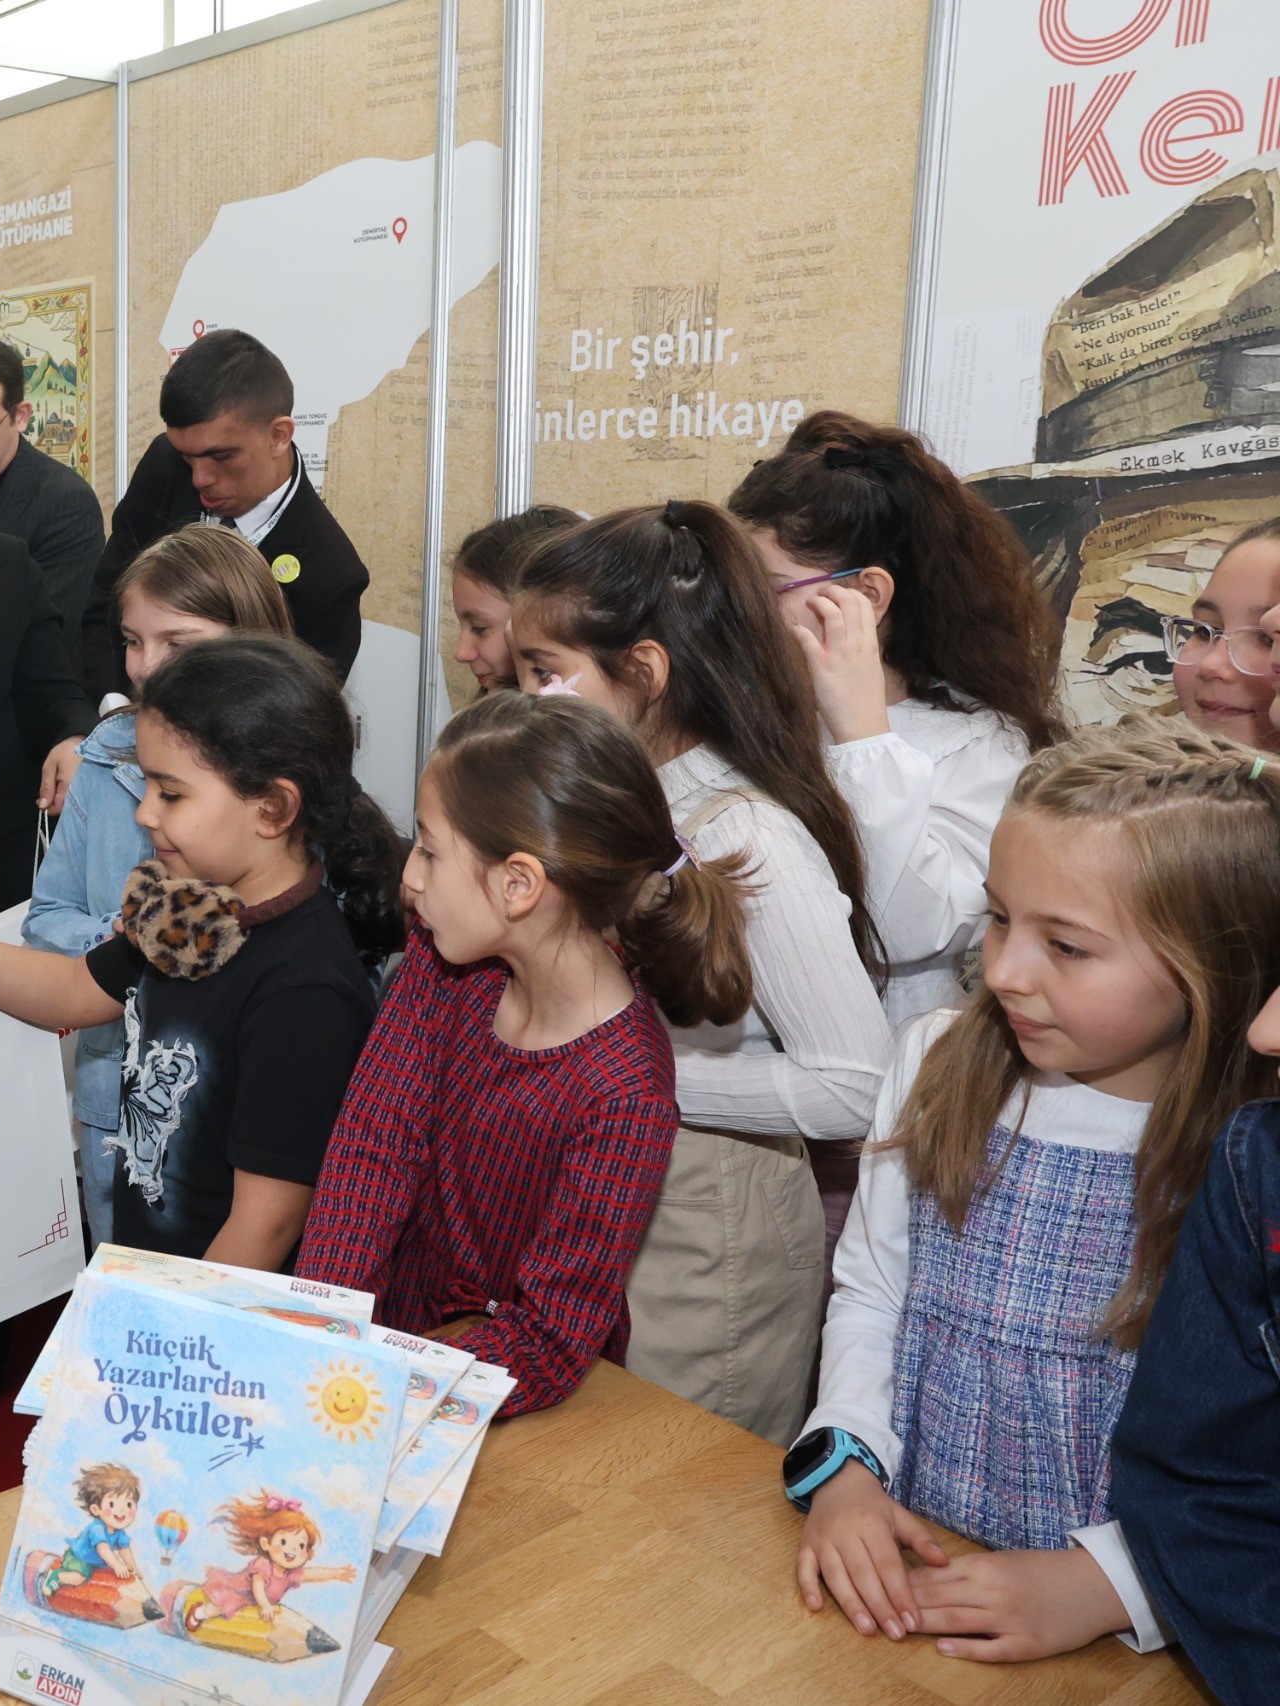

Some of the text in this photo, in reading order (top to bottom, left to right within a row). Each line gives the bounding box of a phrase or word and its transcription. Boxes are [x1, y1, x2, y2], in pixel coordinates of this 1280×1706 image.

[1038, 69, 1280, 207] Ke
[1110, 307, 1135, 329] bak
[570, 327, 622, 372] Bir
[631, 317, 739, 380] şehir,
[1120, 345, 1136, 361] da
[1140, 336, 1174, 353] birer
[1178, 322, 1222, 342] cigara
[534, 391, 805, 448] inlerce hikaye
[1120, 449, 1186, 472] Ekmek
[126, 1329, 221, 1370] Küçük
[94, 1358, 265, 1400] Yazarlardan
[104, 1386, 253, 1444] Öyküler
[37, 1677, 81, 1705] AYDIN
[40, 1663, 85, 1690] ERKAN
